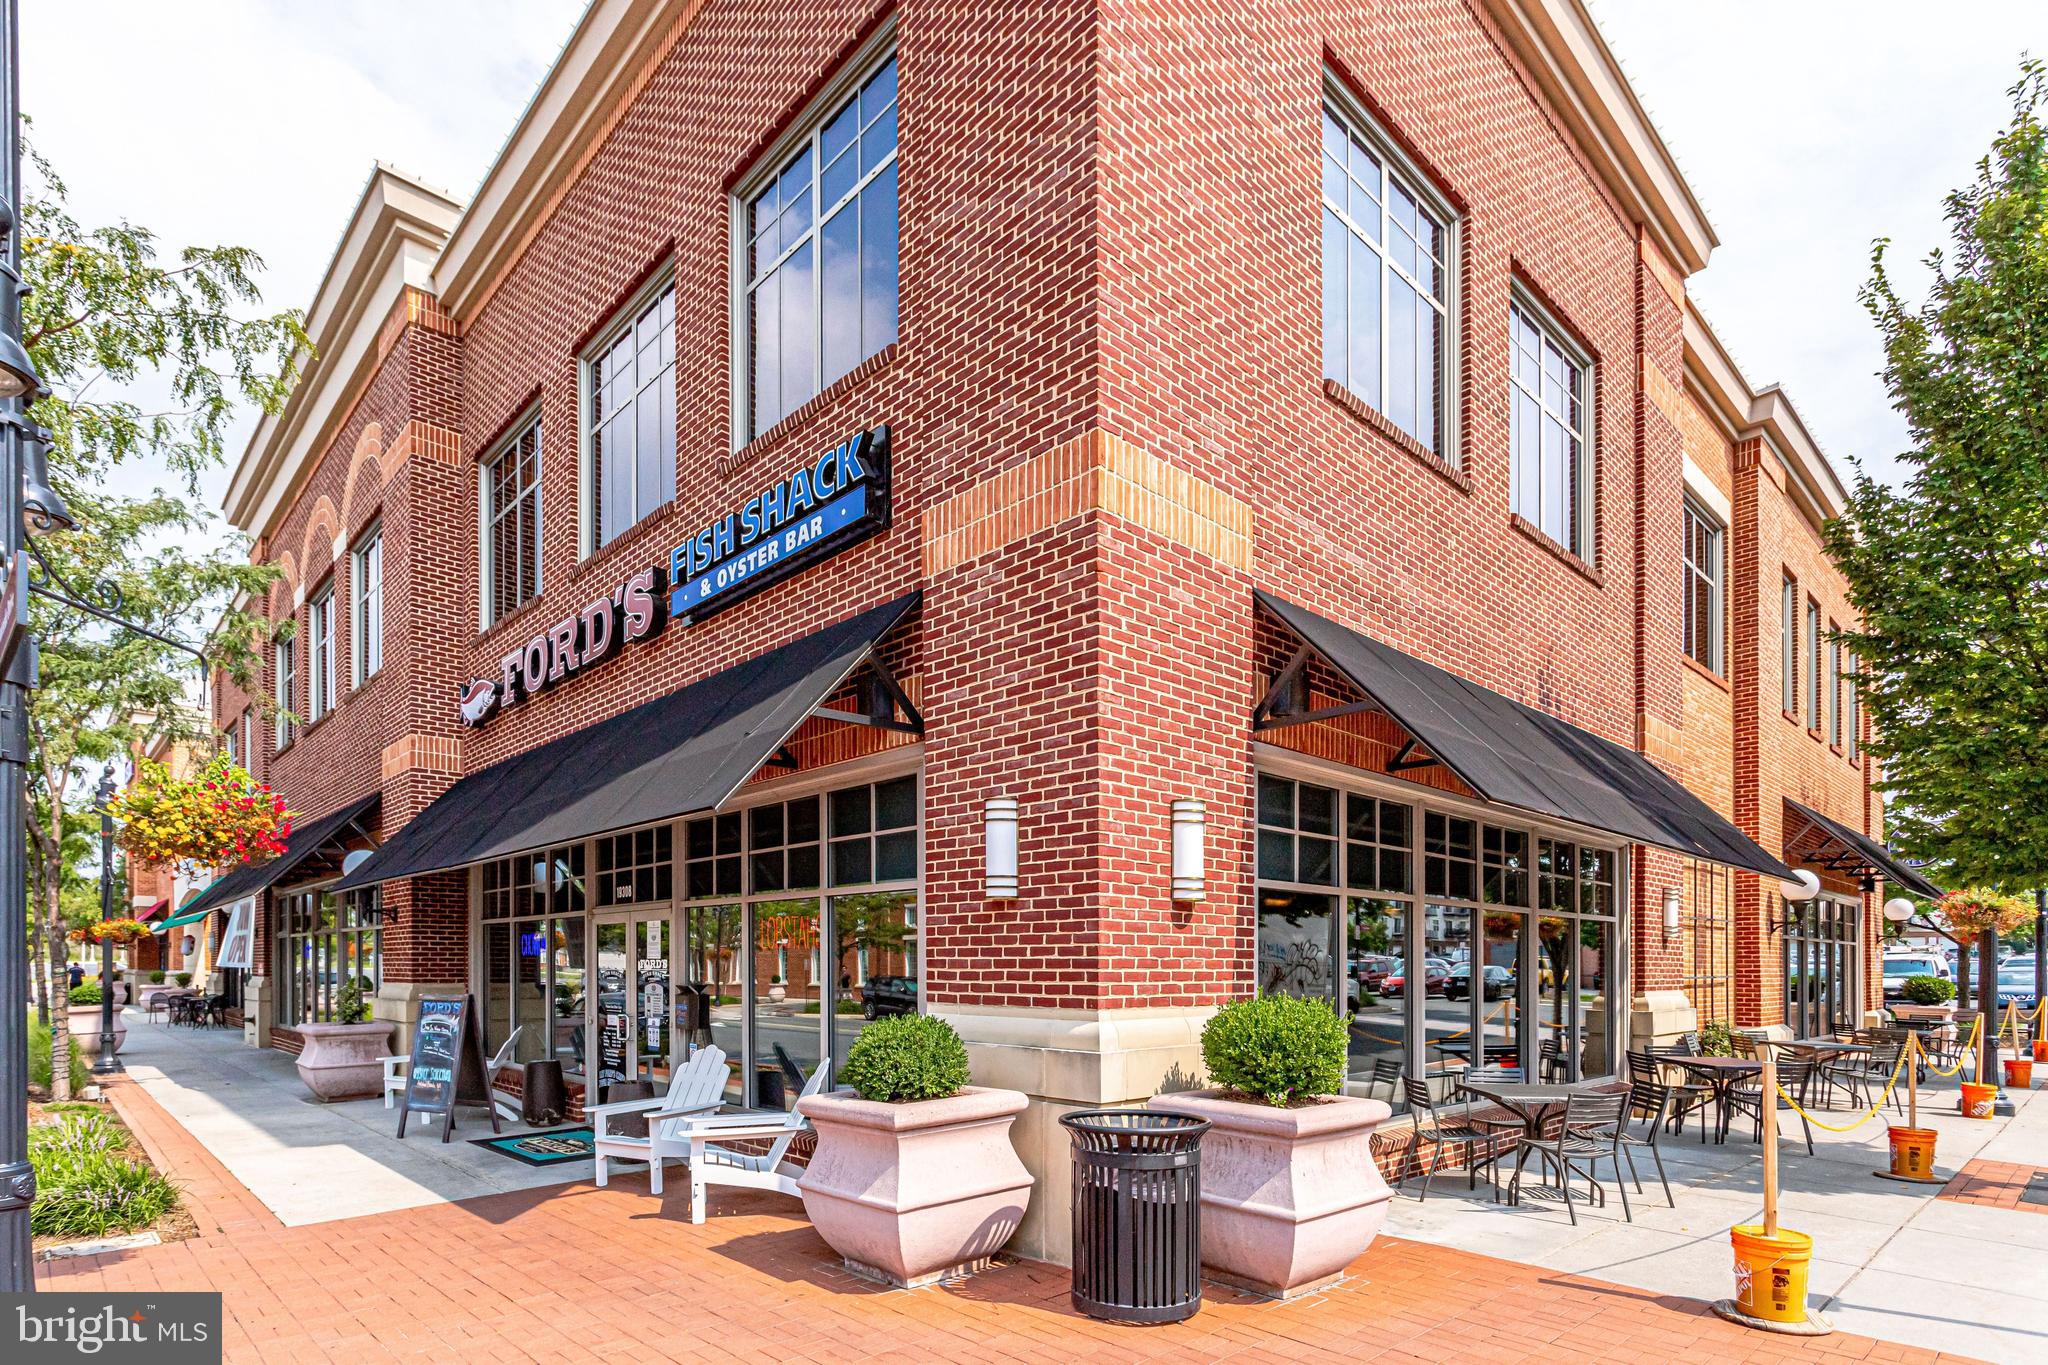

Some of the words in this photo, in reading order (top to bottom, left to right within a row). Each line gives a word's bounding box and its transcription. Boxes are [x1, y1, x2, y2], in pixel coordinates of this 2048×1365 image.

[671, 513, 734, 586] FISH
[740, 430, 865, 546] SHACK
[700, 577, 712, 598] &
[716, 540, 779, 588] OYSTER
[785, 515, 823, 553] BAR
[501, 567, 654, 708] FORD'S
